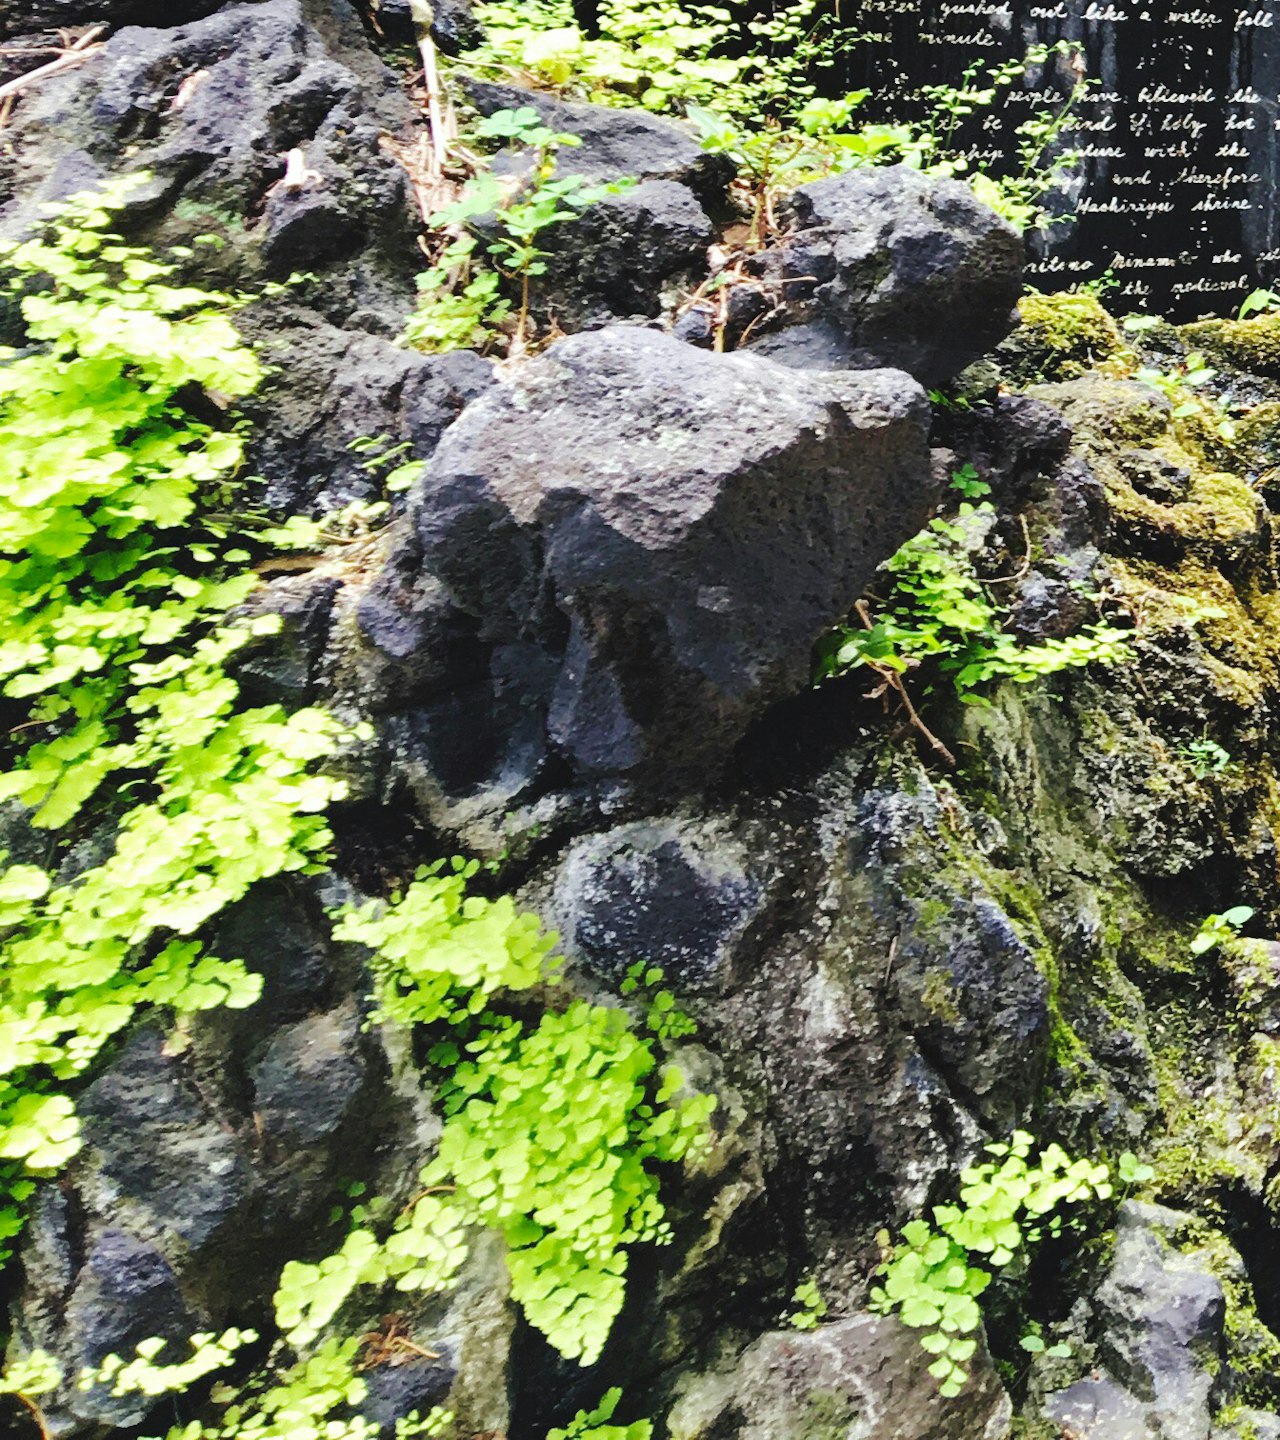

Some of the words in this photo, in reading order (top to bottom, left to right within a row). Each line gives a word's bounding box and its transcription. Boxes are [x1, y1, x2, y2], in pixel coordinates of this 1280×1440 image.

[1030, 1, 1068, 19] out
[1081, 3, 1128, 21] like
[1139, 11, 1152, 21] a
[1004, 87, 1064, 109] people
[1228, 86, 1262, 104] the
[982, 115, 1002, 130] be
[1215, 144, 1250, 158] the
